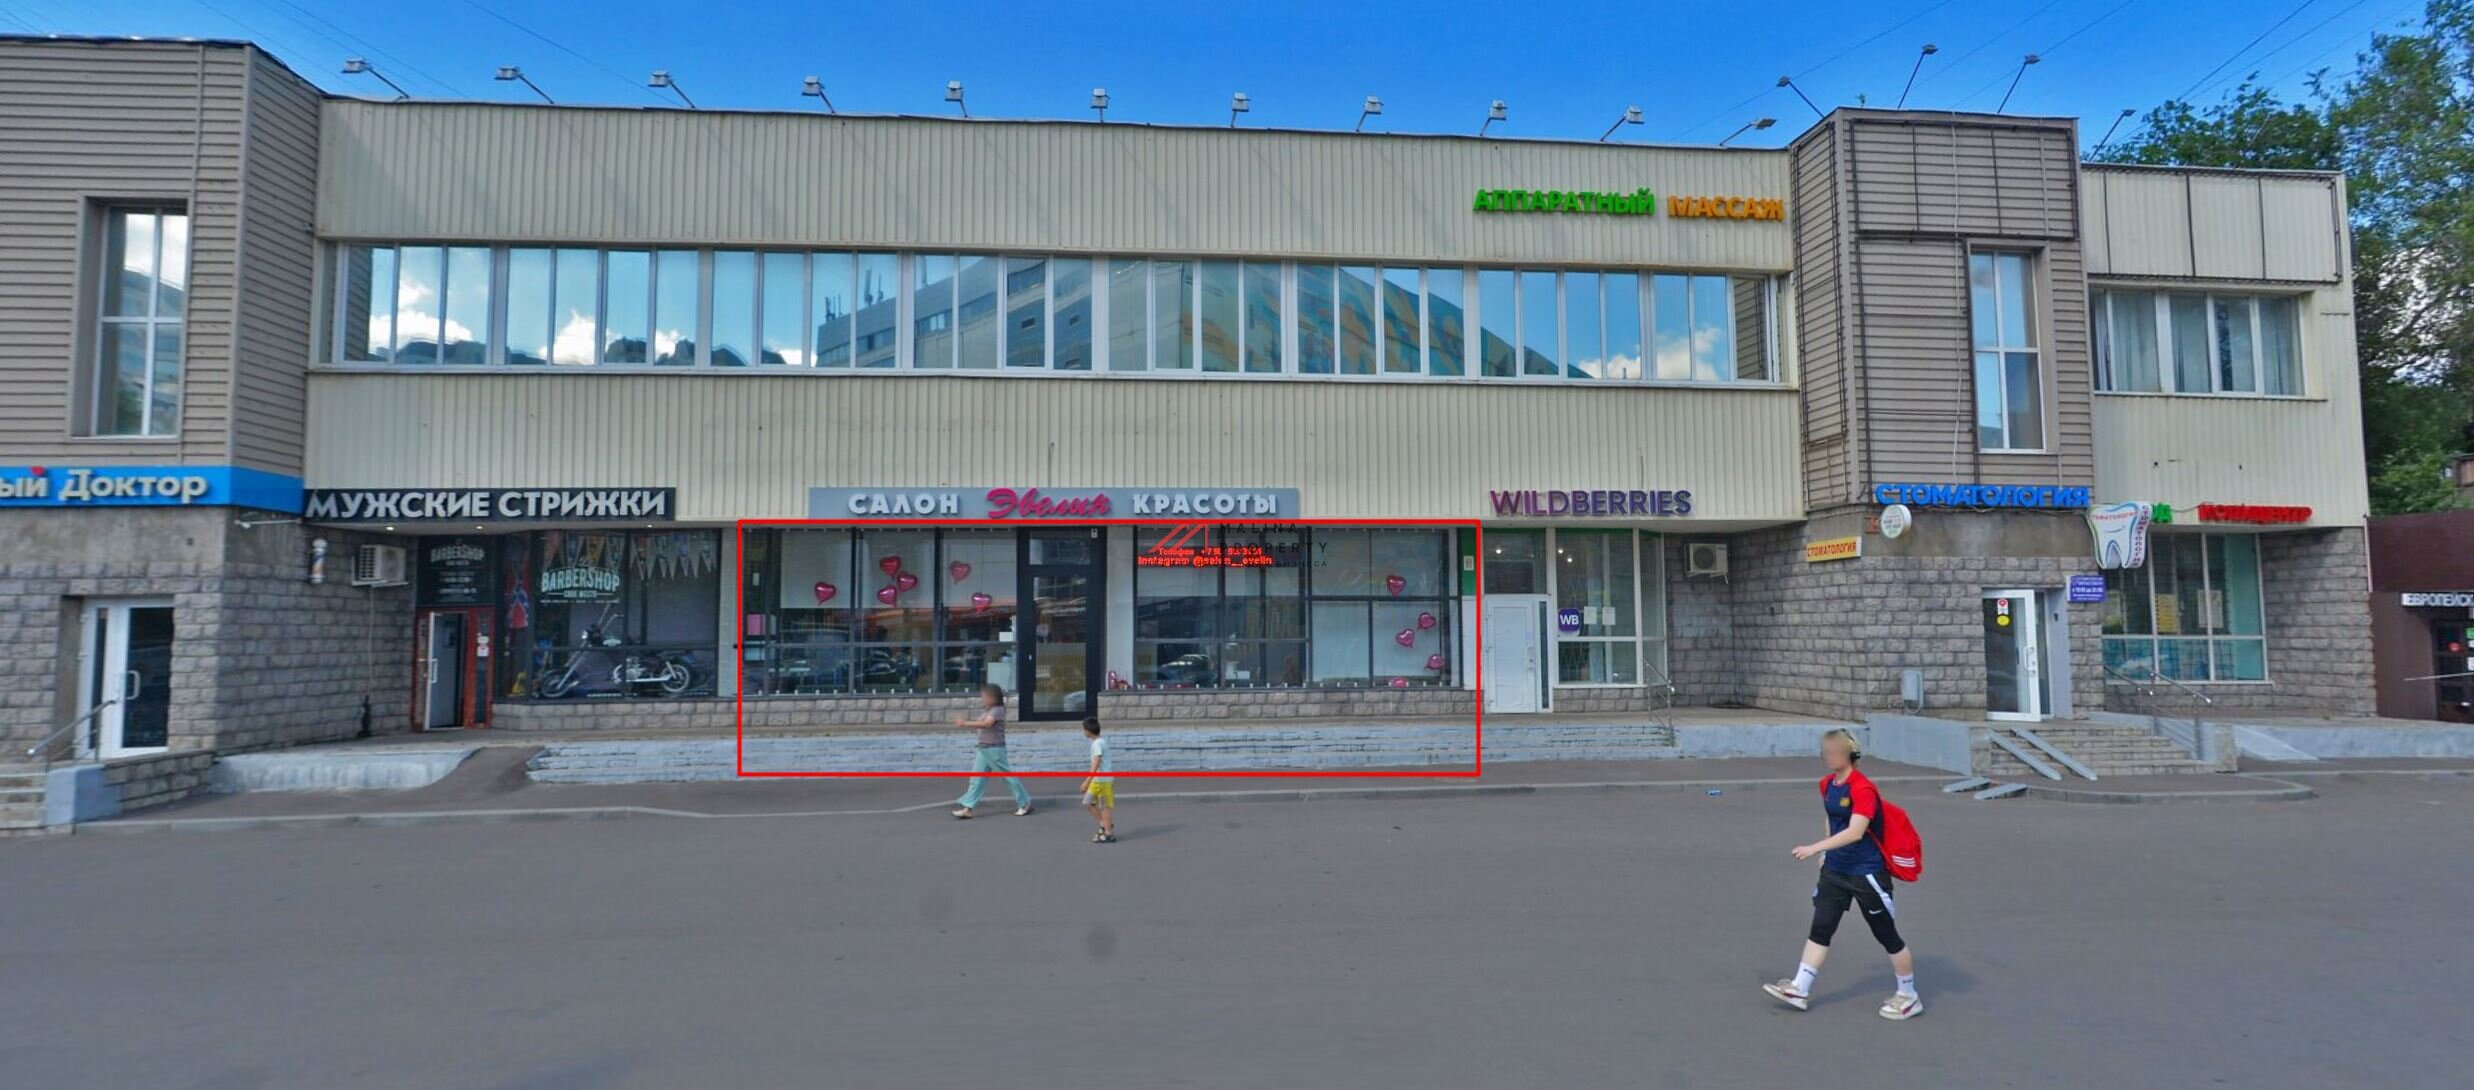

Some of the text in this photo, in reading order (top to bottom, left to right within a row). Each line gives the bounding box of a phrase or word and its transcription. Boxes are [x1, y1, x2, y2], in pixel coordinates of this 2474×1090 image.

[1473, 187, 1785, 221] АППАРАТНЫЙ МАССАЖ
[58, 468, 208, 504] Доктор
[1875, 483, 2089, 507] СТОМАТОЛОГИЯ
[305, 489, 665, 519] МУЖСКИЕ СТРИЖКИ
[848, 493, 959, 515] САЛОН
[1132, 493, 1278, 515] КРАСОТЫ
[1489, 490, 1692, 517] WILDBERRIES
[541, 567, 620, 592] BARBERSHOP
[1560, 614, 1580, 625] WB
